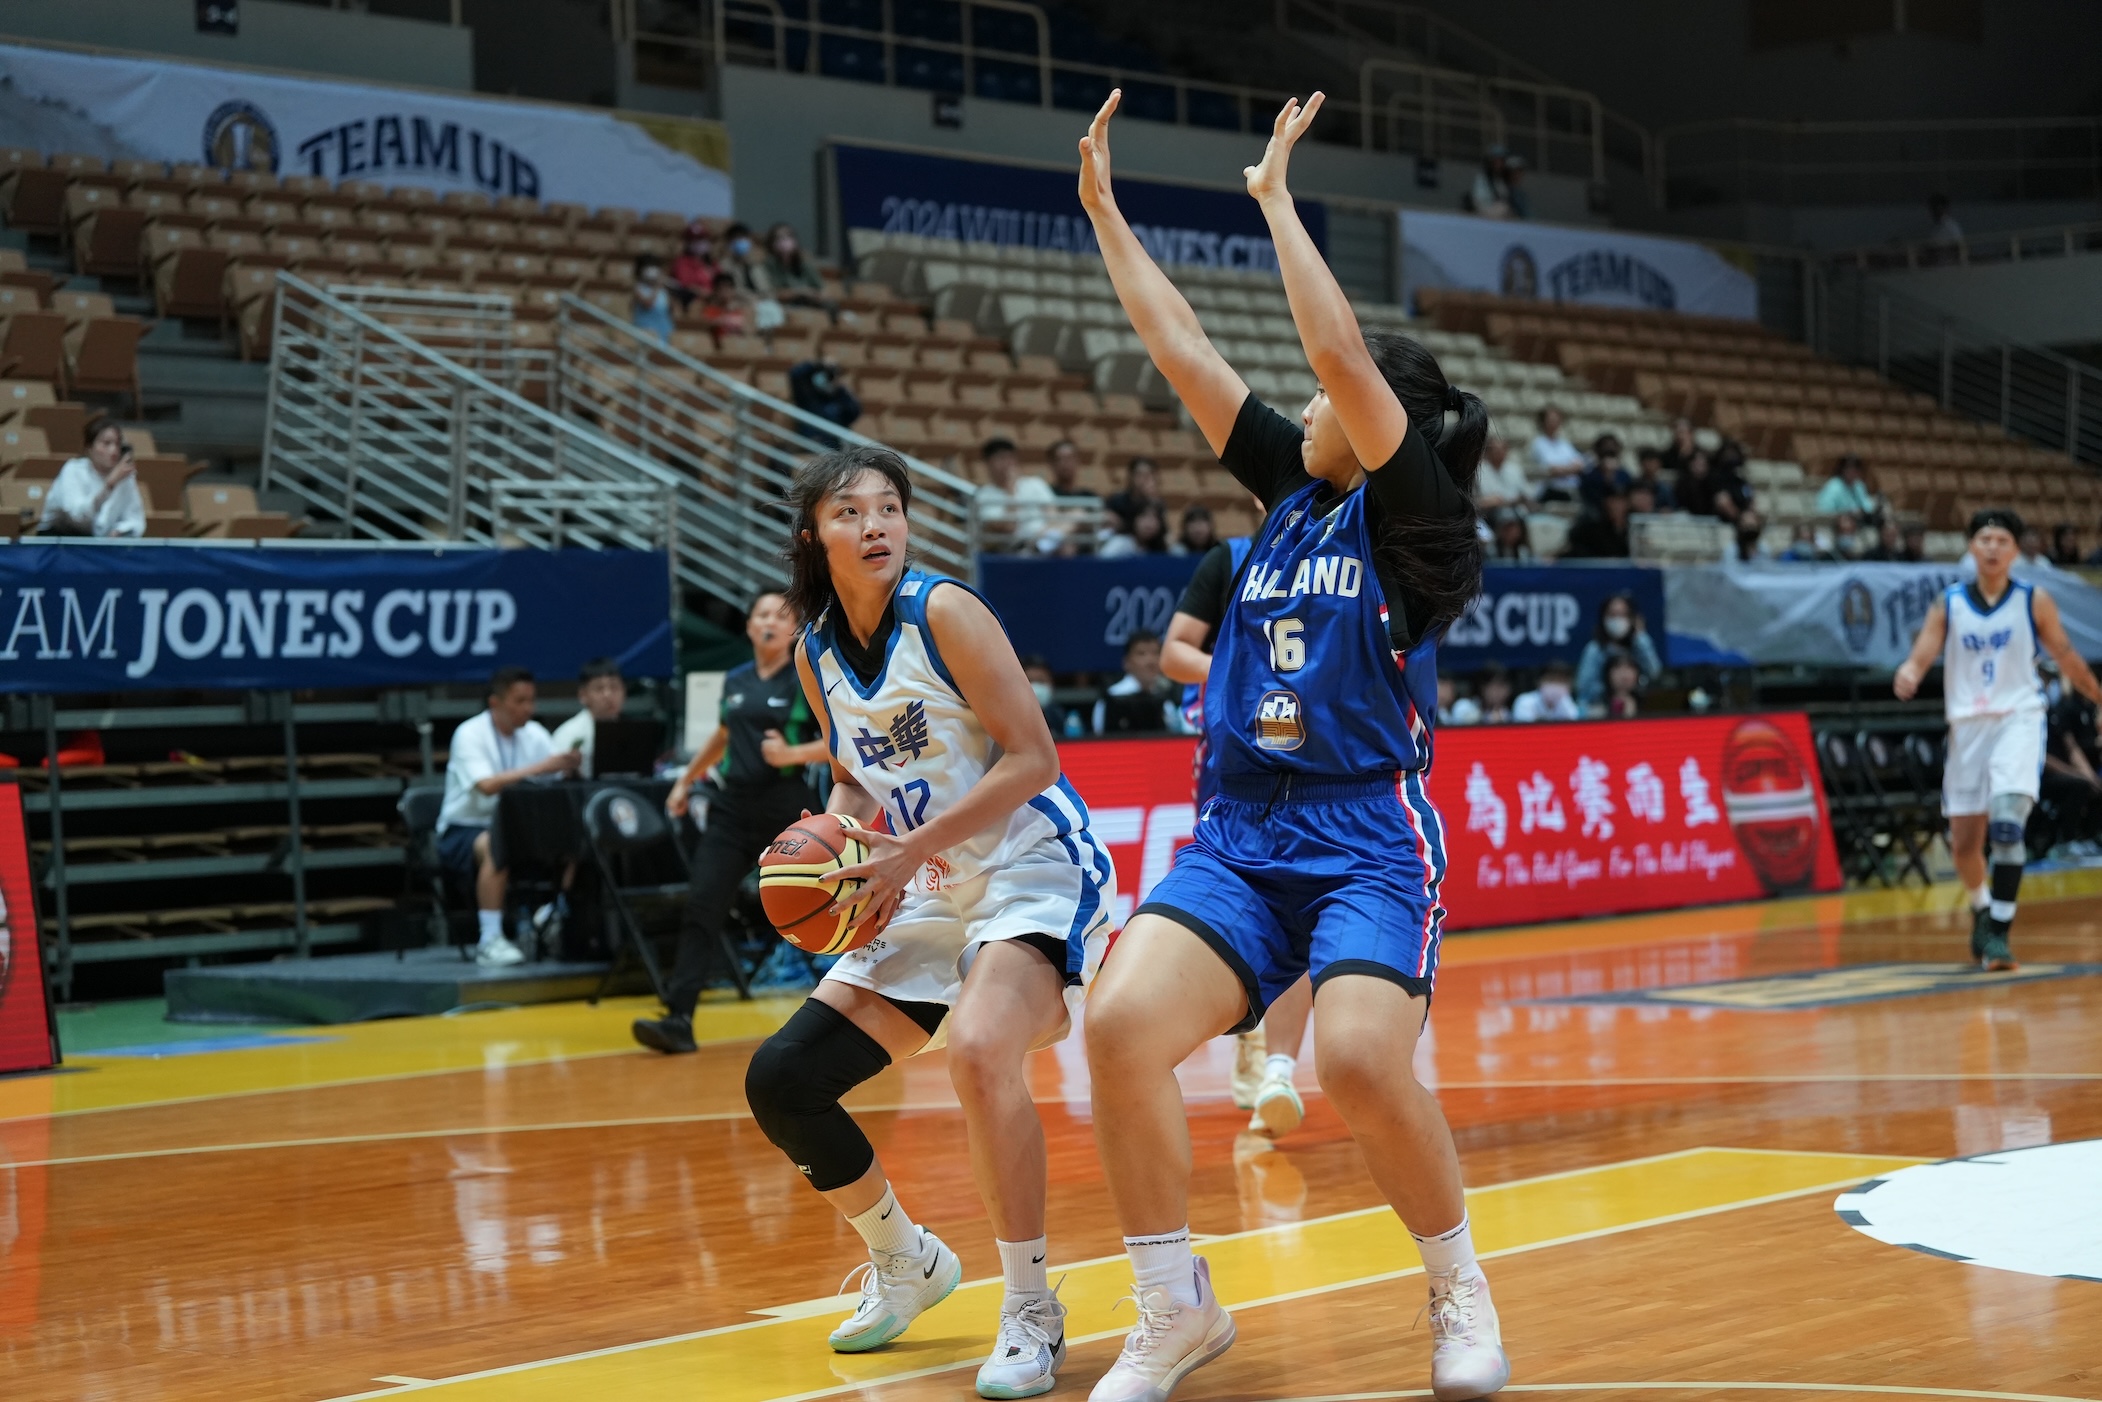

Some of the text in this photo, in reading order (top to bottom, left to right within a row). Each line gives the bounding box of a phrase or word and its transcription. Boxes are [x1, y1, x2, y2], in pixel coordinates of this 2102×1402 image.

[299, 114, 461, 177] TEAM
[468, 131, 541, 200] UP
[881, 195, 960, 242] 2024
[1130, 223, 1221, 268] ONES
[0, 588, 517, 678] AM JONES CUP
[1104, 585, 1187, 646] 202
[1494, 592, 1581, 646] CUP
[1263, 617, 1306, 672] 16
[1981, 659, 1996, 687] 9
[852, 699, 929, 771] 中華
[890, 778, 932, 831] 12
